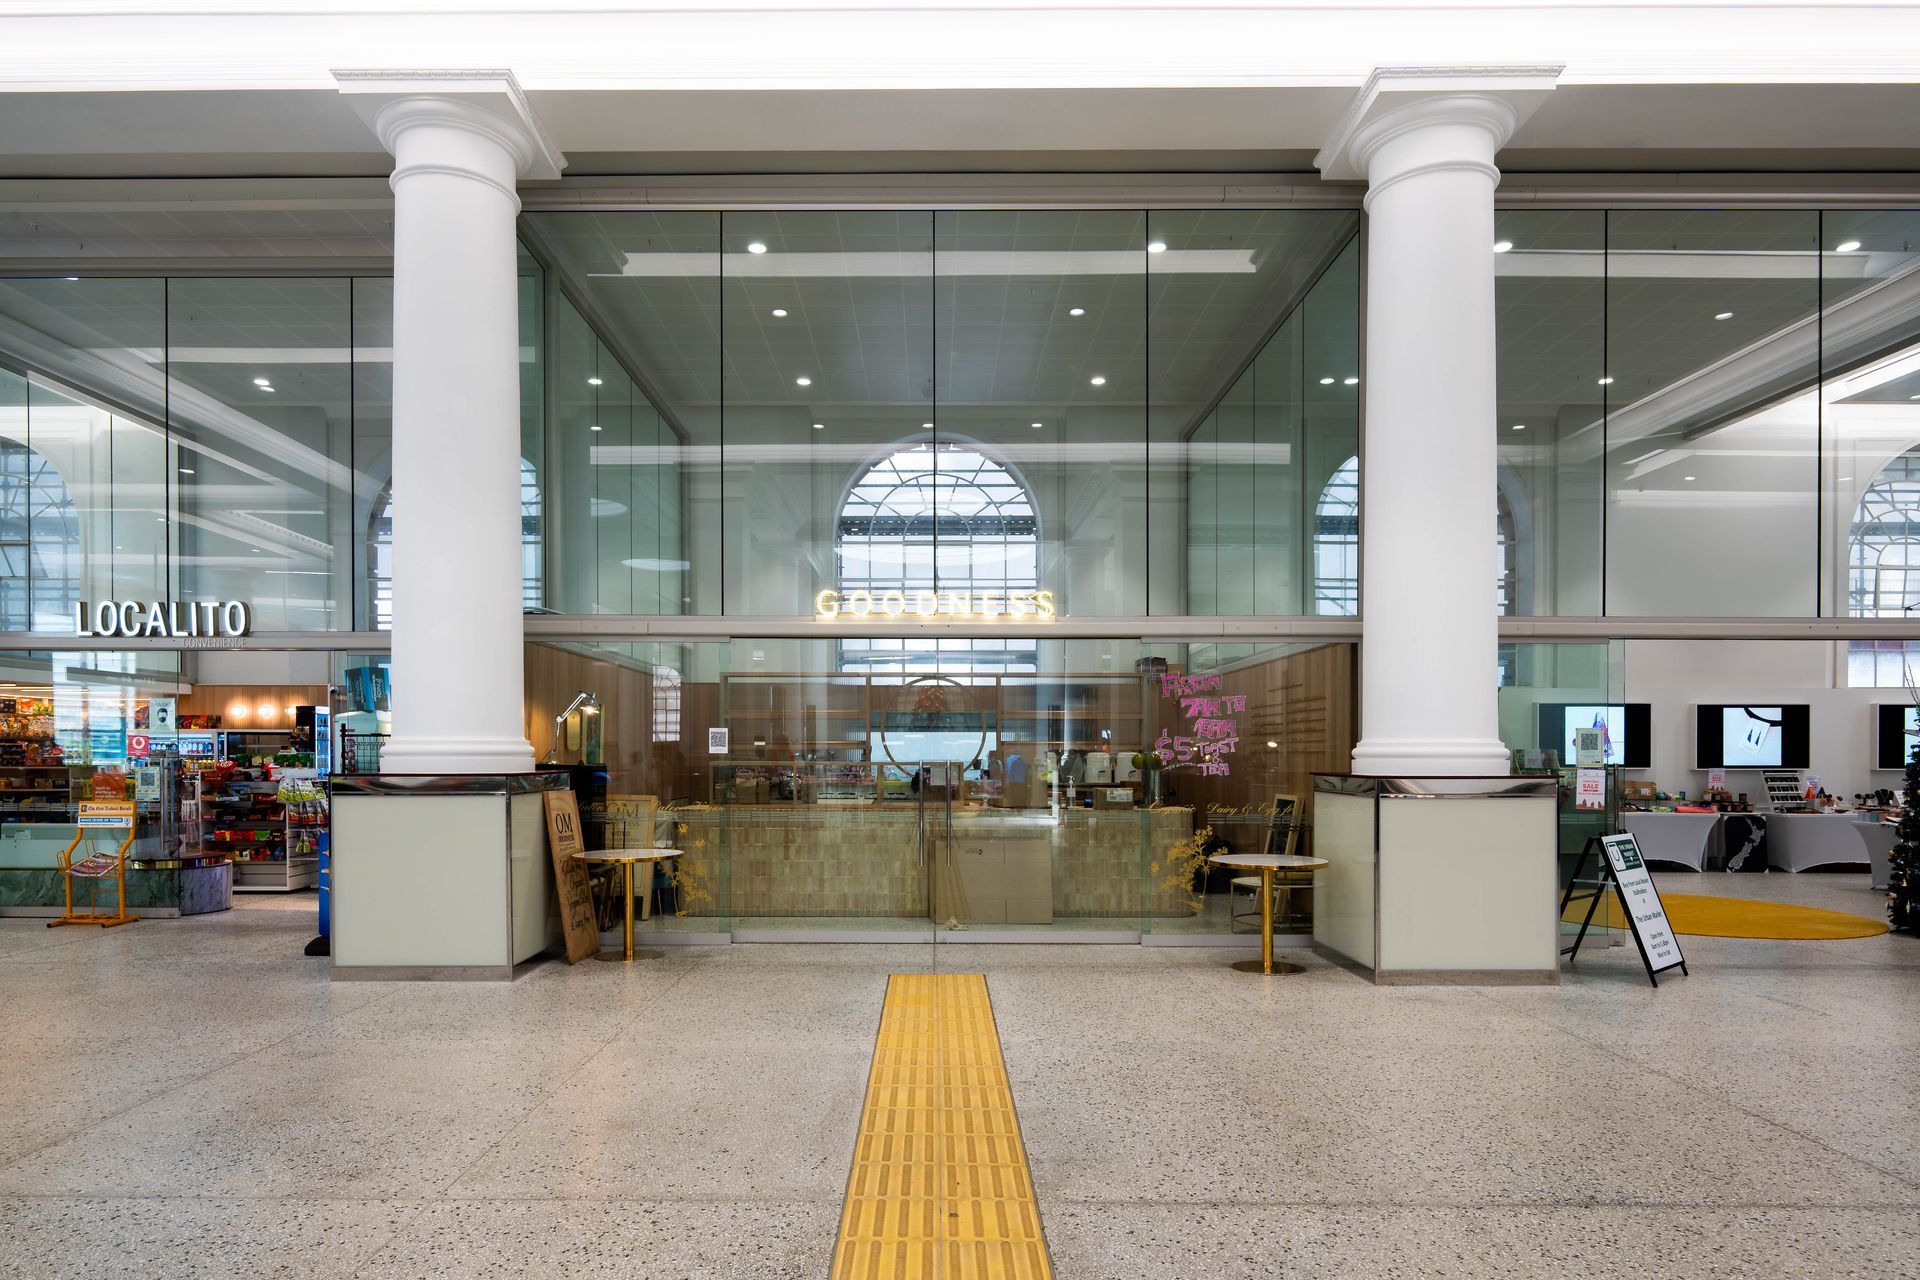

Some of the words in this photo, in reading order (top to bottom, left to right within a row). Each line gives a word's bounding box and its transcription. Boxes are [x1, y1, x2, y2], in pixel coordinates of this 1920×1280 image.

[815, 589, 1055, 618] GOODNESS
[76, 600, 249, 637] LOCALITO
[183, 637, 247, 648] CONVENIENCE
[1161, 672, 1223, 698] FROM
[1180, 698, 1221, 718] 7AM
[1155, 728, 1194, 766] $5
[1197, 762, 1230, 777] TEA
[1207, 802, 1239, 815] Dairy
[1242, 805, 1252, 816] &
[1258, 802, 1279, 816] Egg
[555, 813, 573, 834] OM
[1635, 915, 1643, 923] The
[1643, 913, 1653, 922] Urban
[1652, 911, 1662, 919] Market
